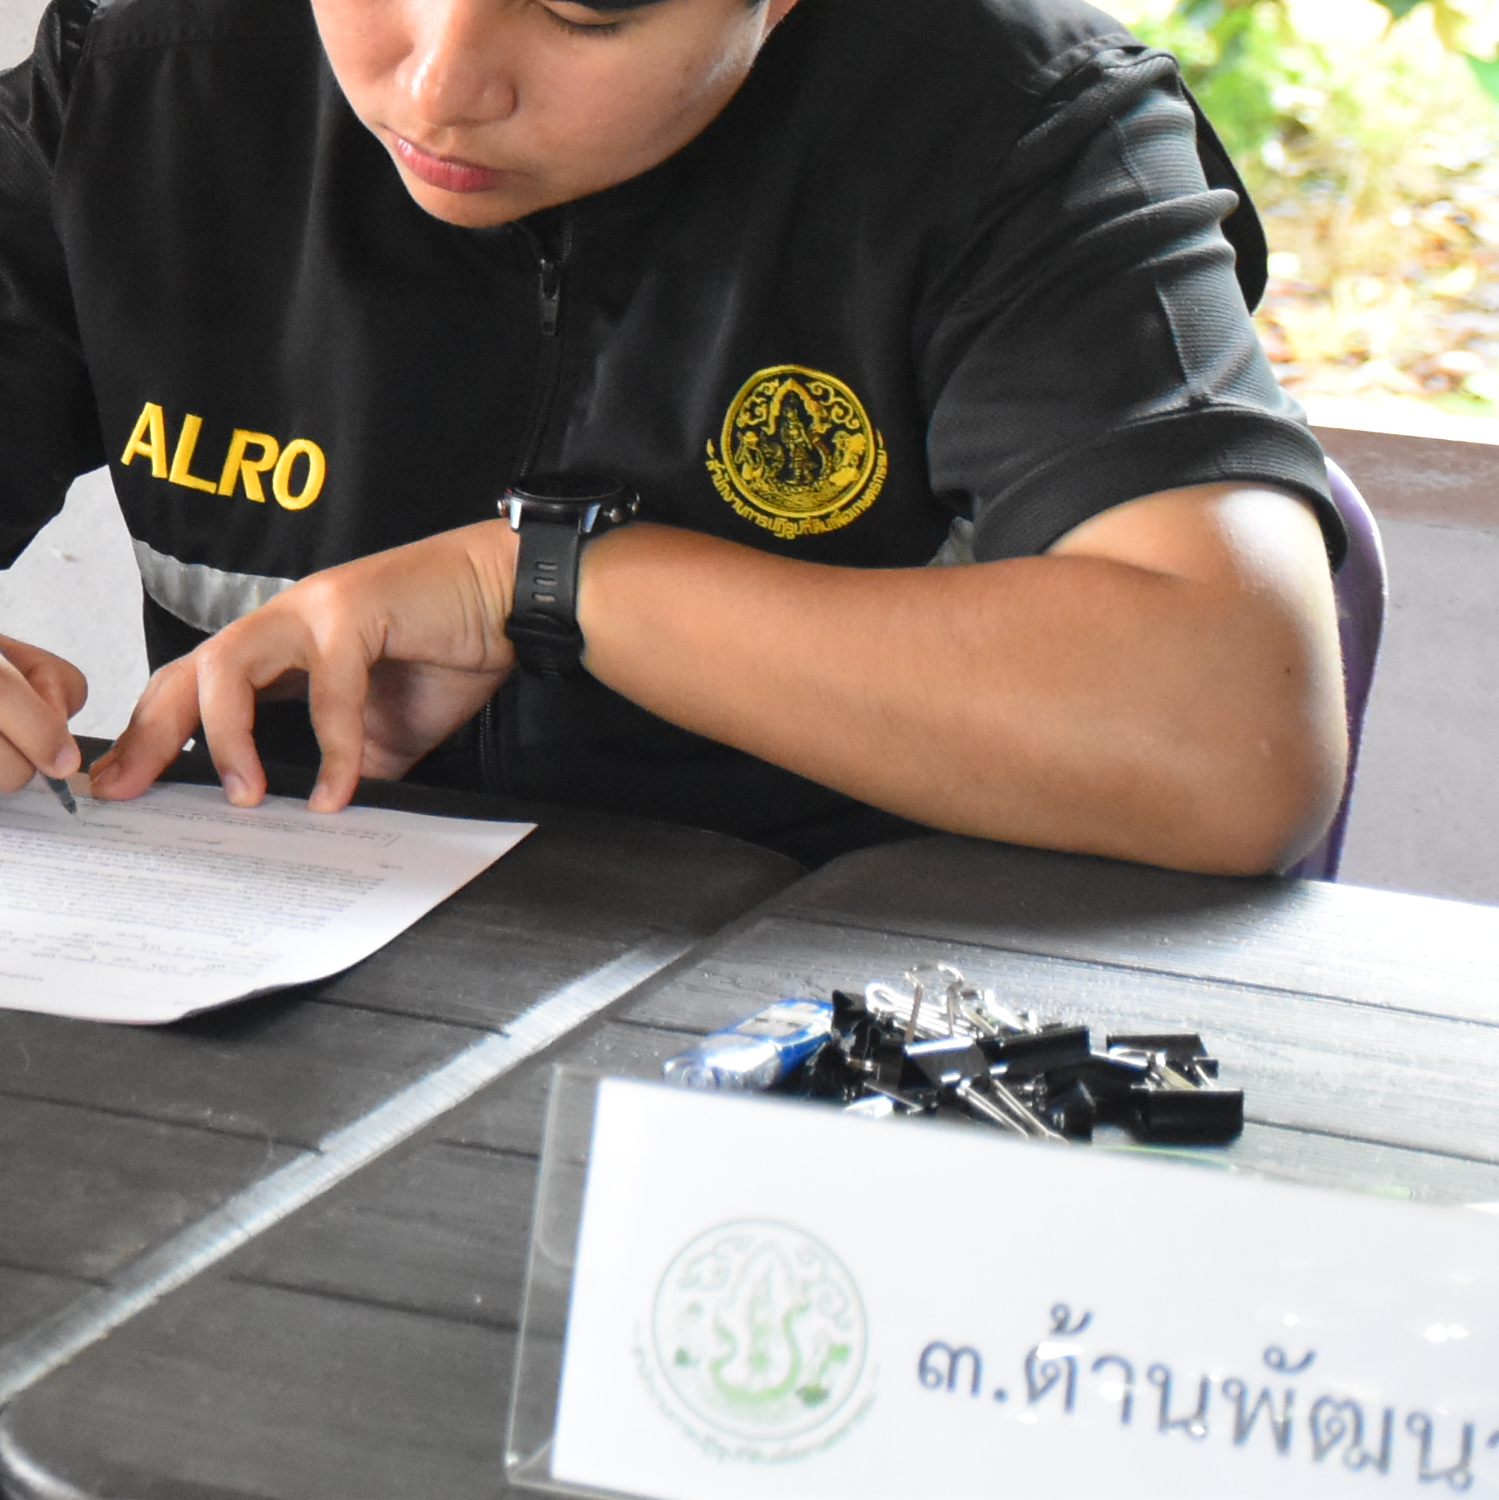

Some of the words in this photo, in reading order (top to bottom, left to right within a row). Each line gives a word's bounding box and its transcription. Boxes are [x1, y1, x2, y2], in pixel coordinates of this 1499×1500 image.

[120, 401, 325, 511] ALRO
[917, 1302, 1499, 1492] ๓.ด้านพัฒน
